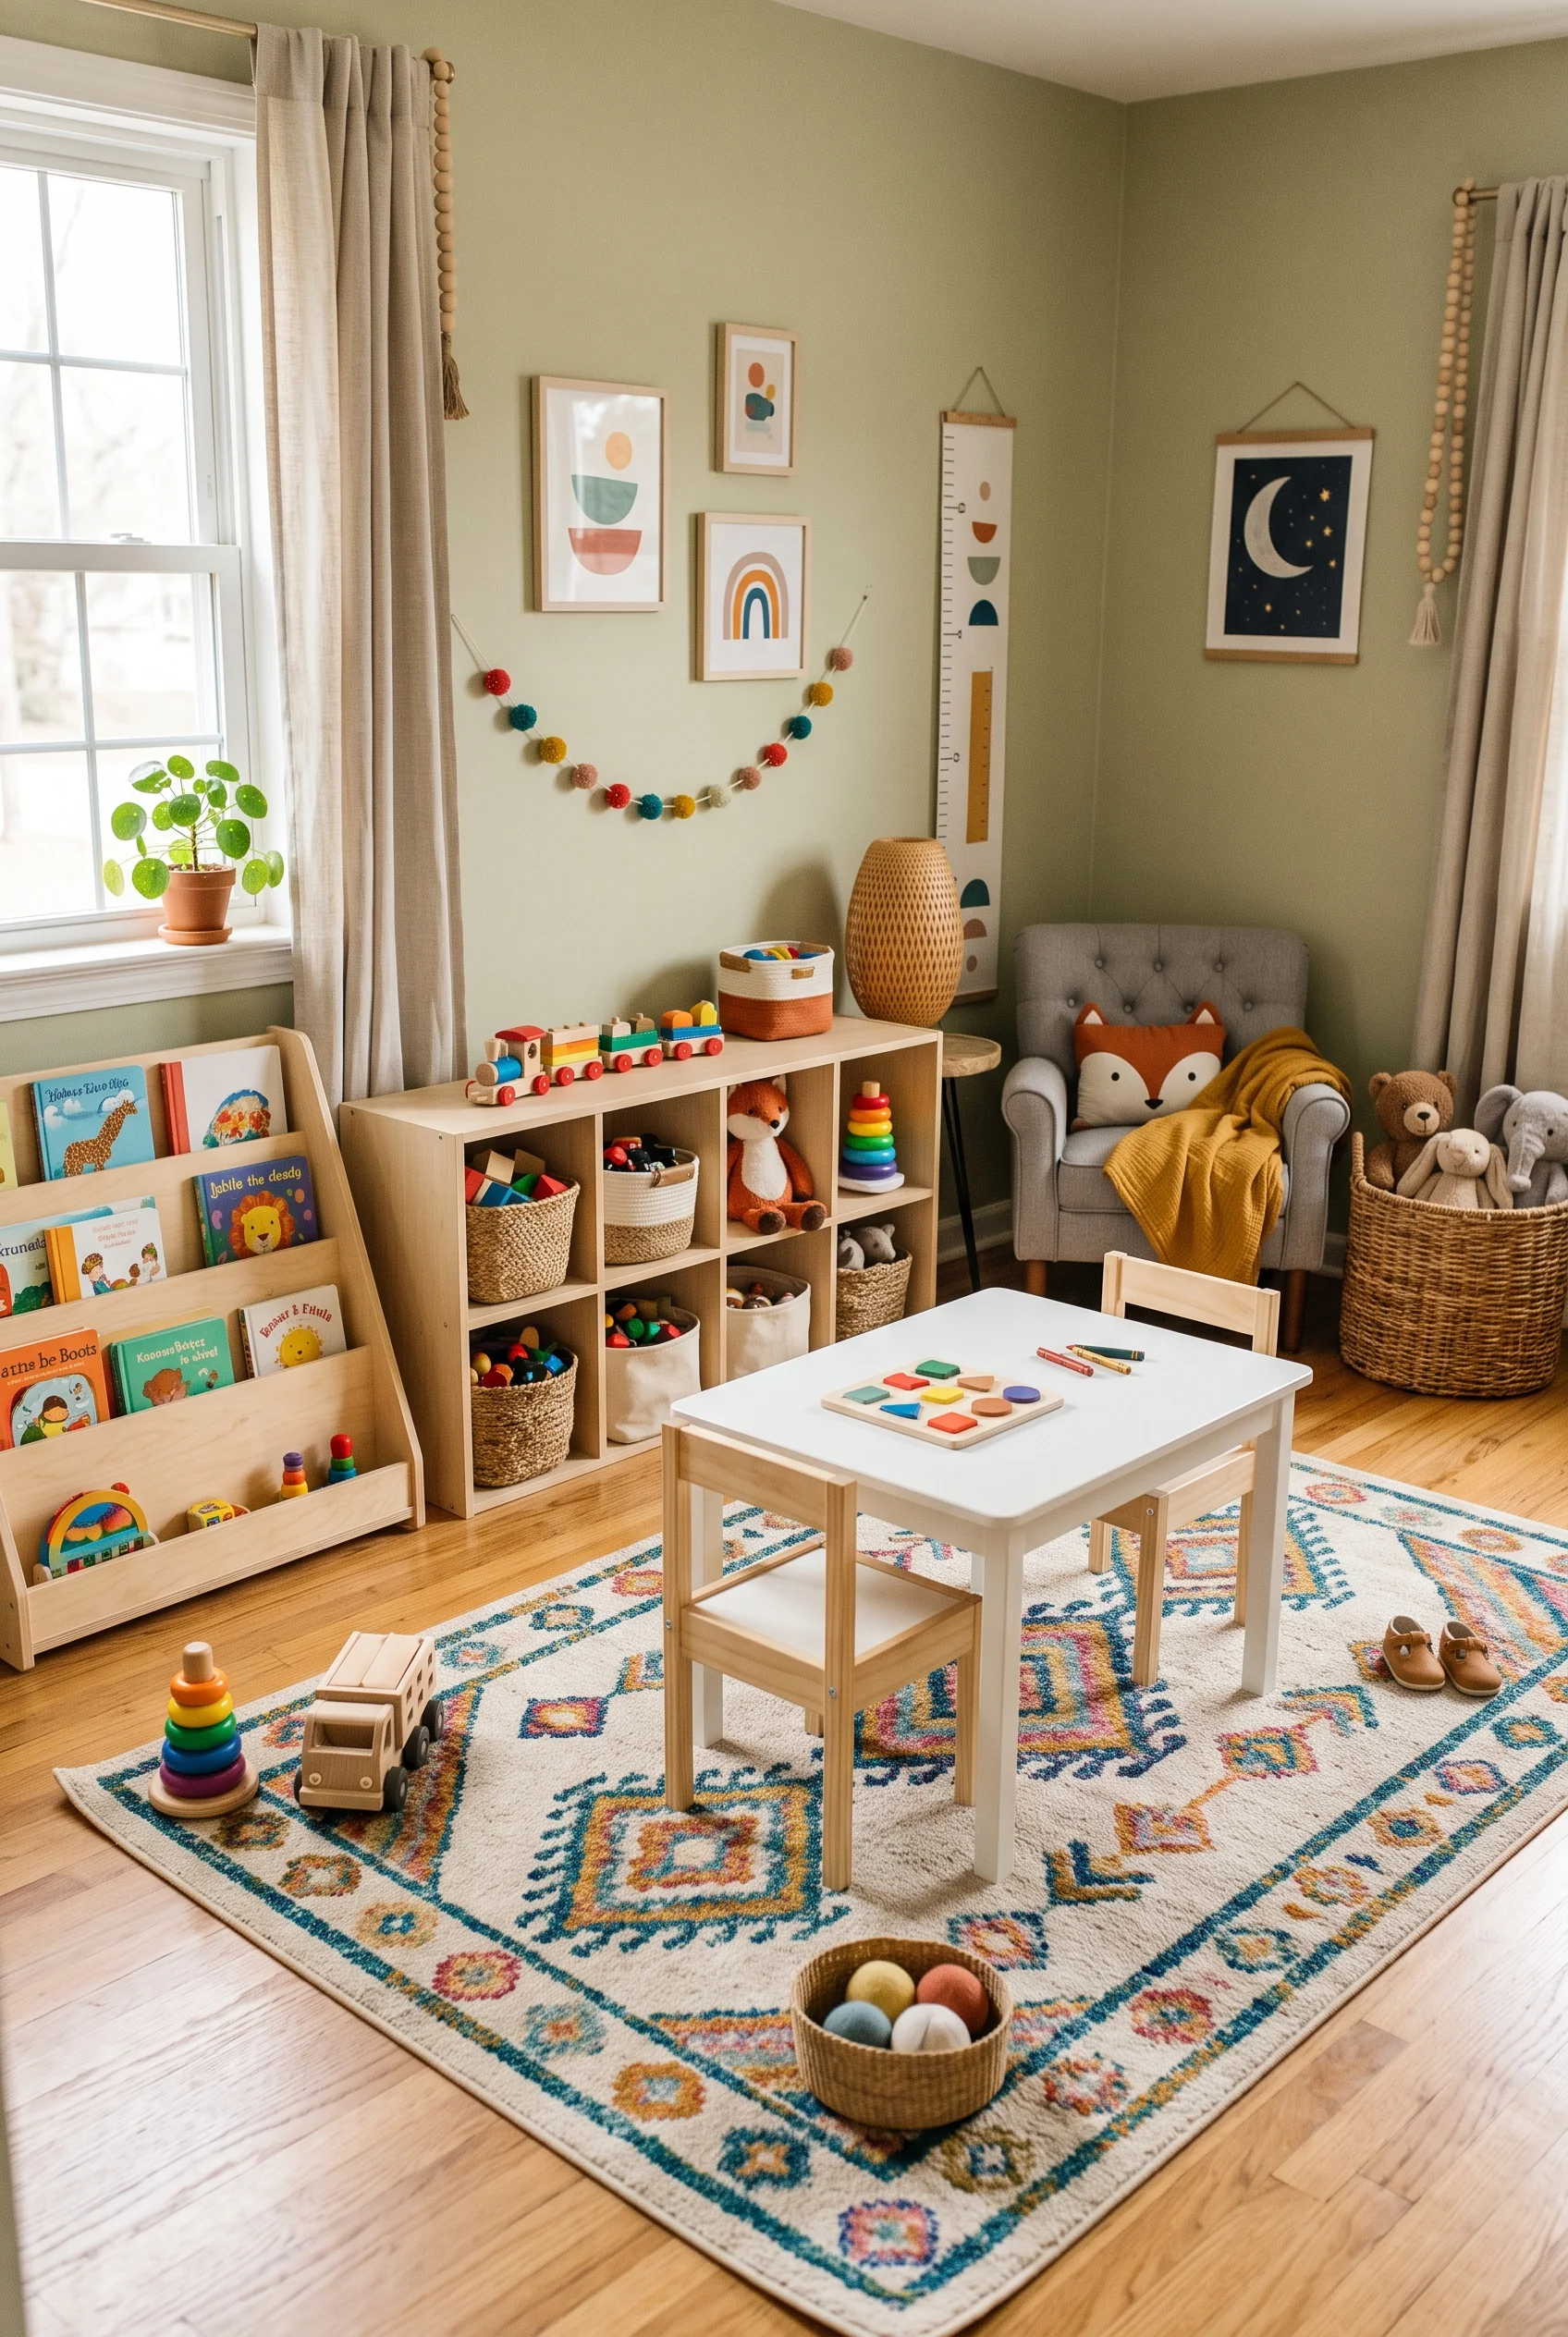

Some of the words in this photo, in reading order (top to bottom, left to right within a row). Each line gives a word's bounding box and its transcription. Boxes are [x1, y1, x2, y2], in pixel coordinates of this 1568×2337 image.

[247, 1174, 264, 1187] the
[38, 1352, 57, 1369] be
[59, 1343, 97, 1364] Boots
